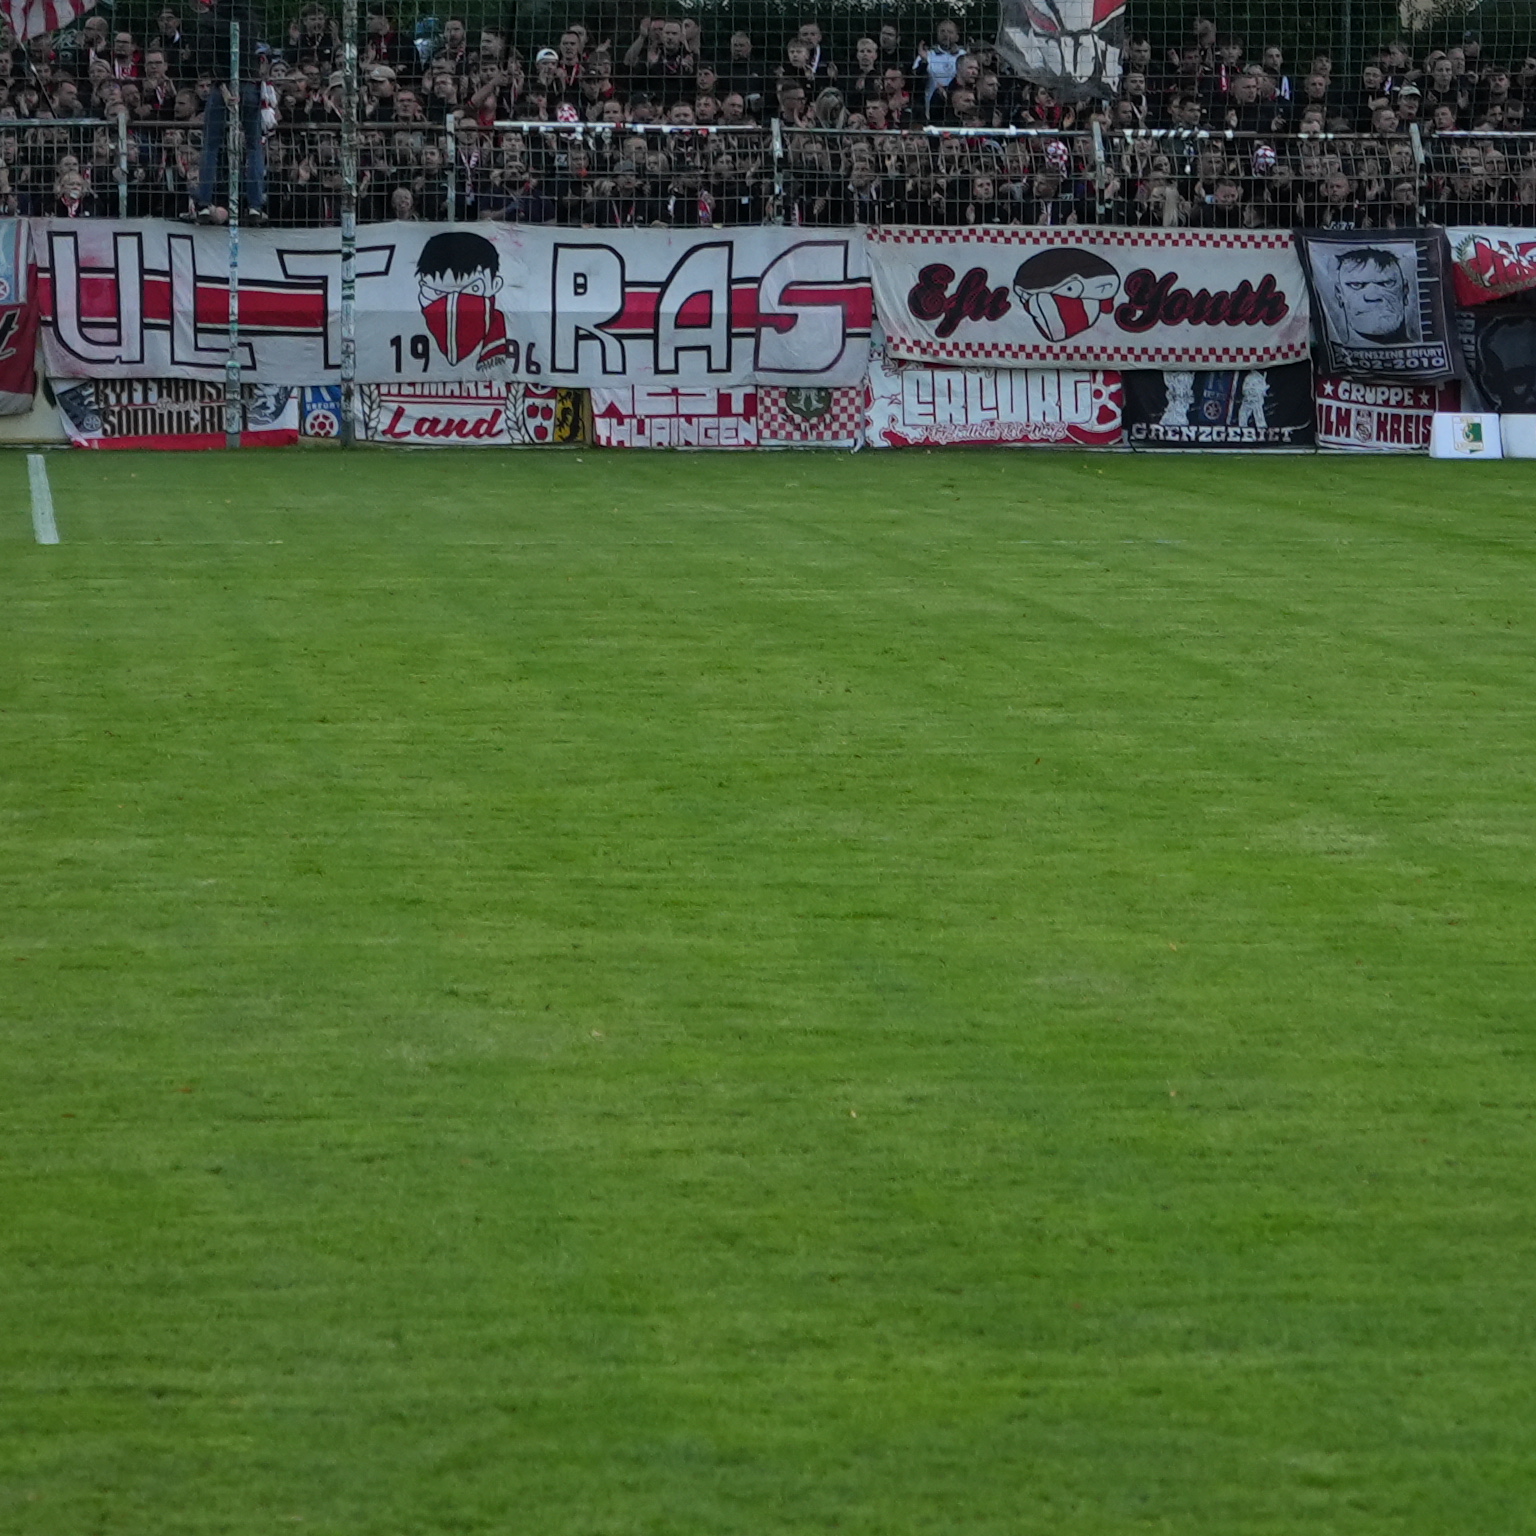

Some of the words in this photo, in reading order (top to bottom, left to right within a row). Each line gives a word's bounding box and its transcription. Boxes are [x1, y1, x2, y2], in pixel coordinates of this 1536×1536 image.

[1114, 268, 1290, 334] Youth
[389, 334, 430, 374] 19
[1406, 346, 1443, 359] ERFURT
[1338, 381, 1414, 406] GRUPPE
[381, 405, 505, 441] Land
[594, 415, 758, 447] THÜRINGEN
[1130, 422, 1293, 444] GRENZGEBIET
[1318, 403, 1352, 439] ILM
[1376, 410, 1432, 445] KREIS
